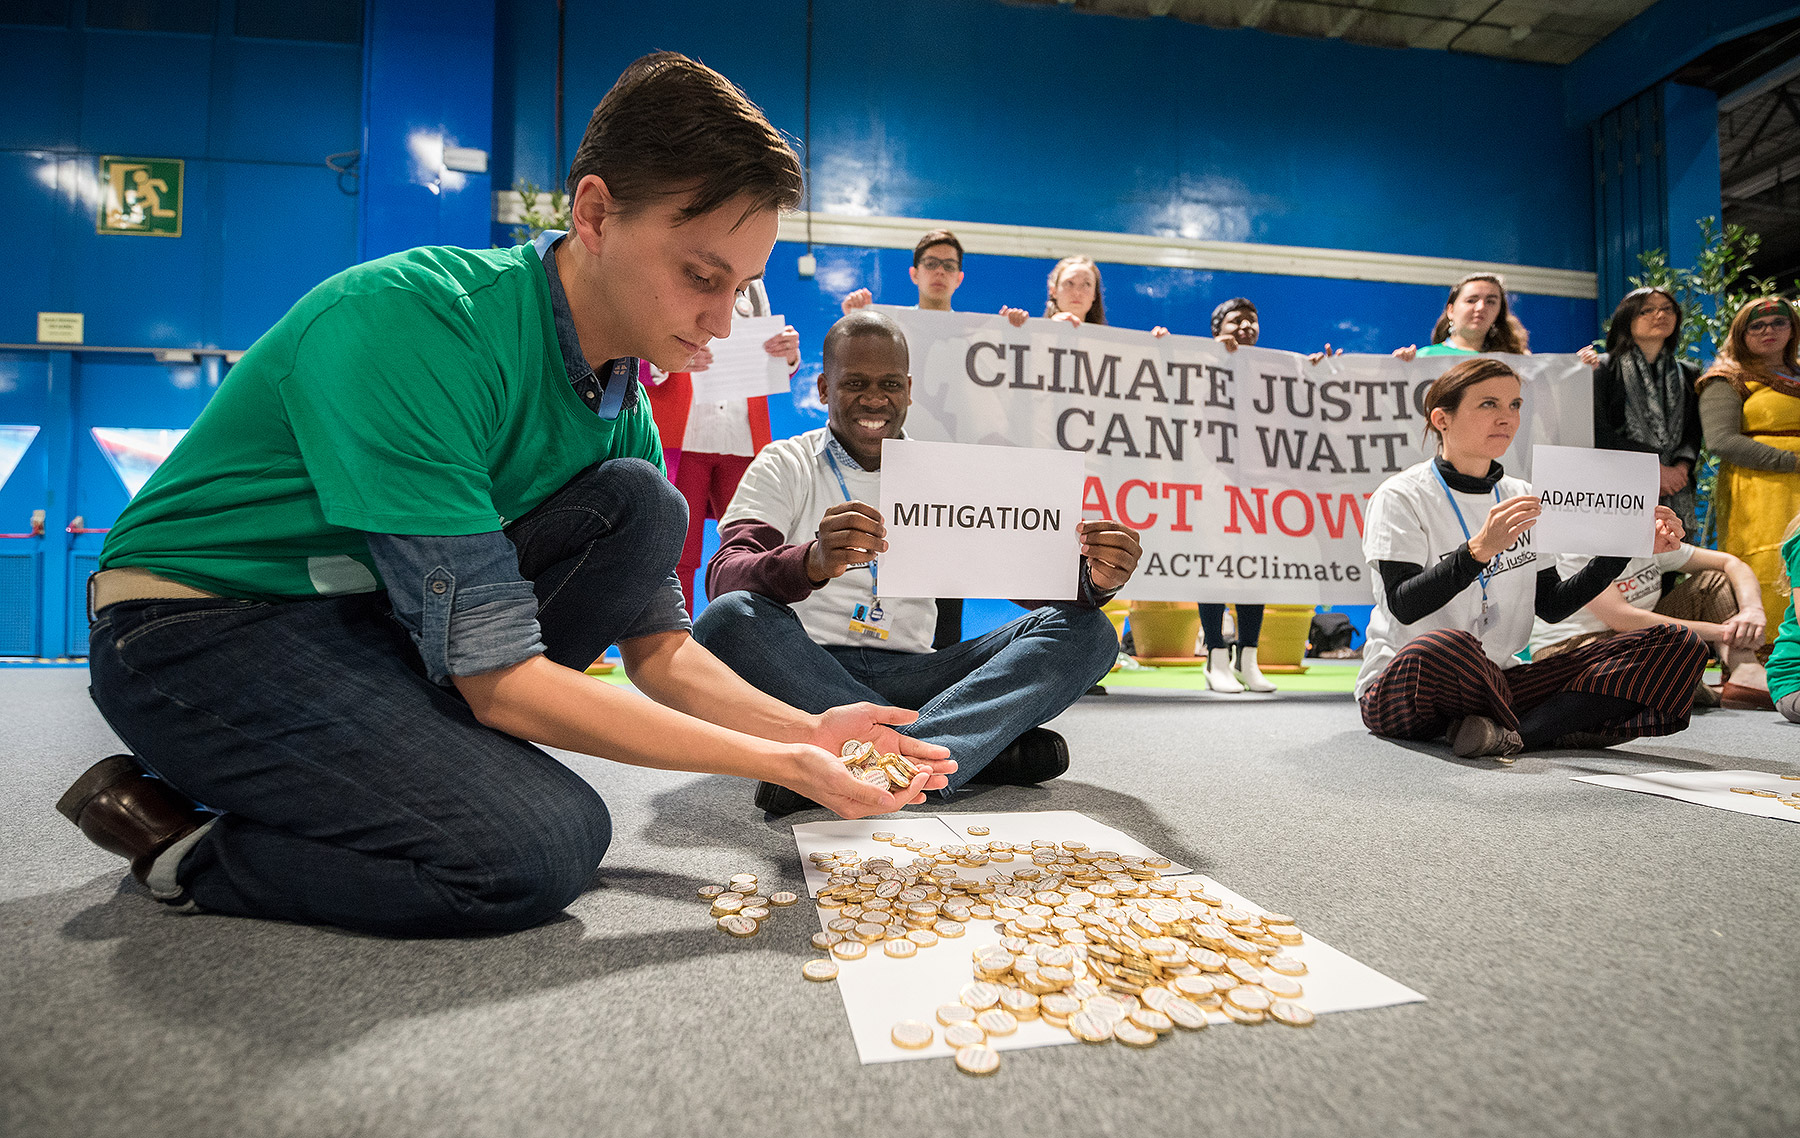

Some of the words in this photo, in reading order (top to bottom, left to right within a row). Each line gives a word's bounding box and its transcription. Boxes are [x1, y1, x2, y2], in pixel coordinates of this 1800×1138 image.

[965, 341, 1235, 410] CLIMATE
[1253, 373, 1437, 422] JUSTIC
[1056, 408, 1238, 464] CAN'T
[1255, 425, 1408, 474] WAIT
[893, 502, 1061, 531] MITIGATION
[1081, 475, 1203, 532] ACT
[1224, 485, 1374, 539] NOW
[1540, 490, 1645, 510] ADAPTATION
